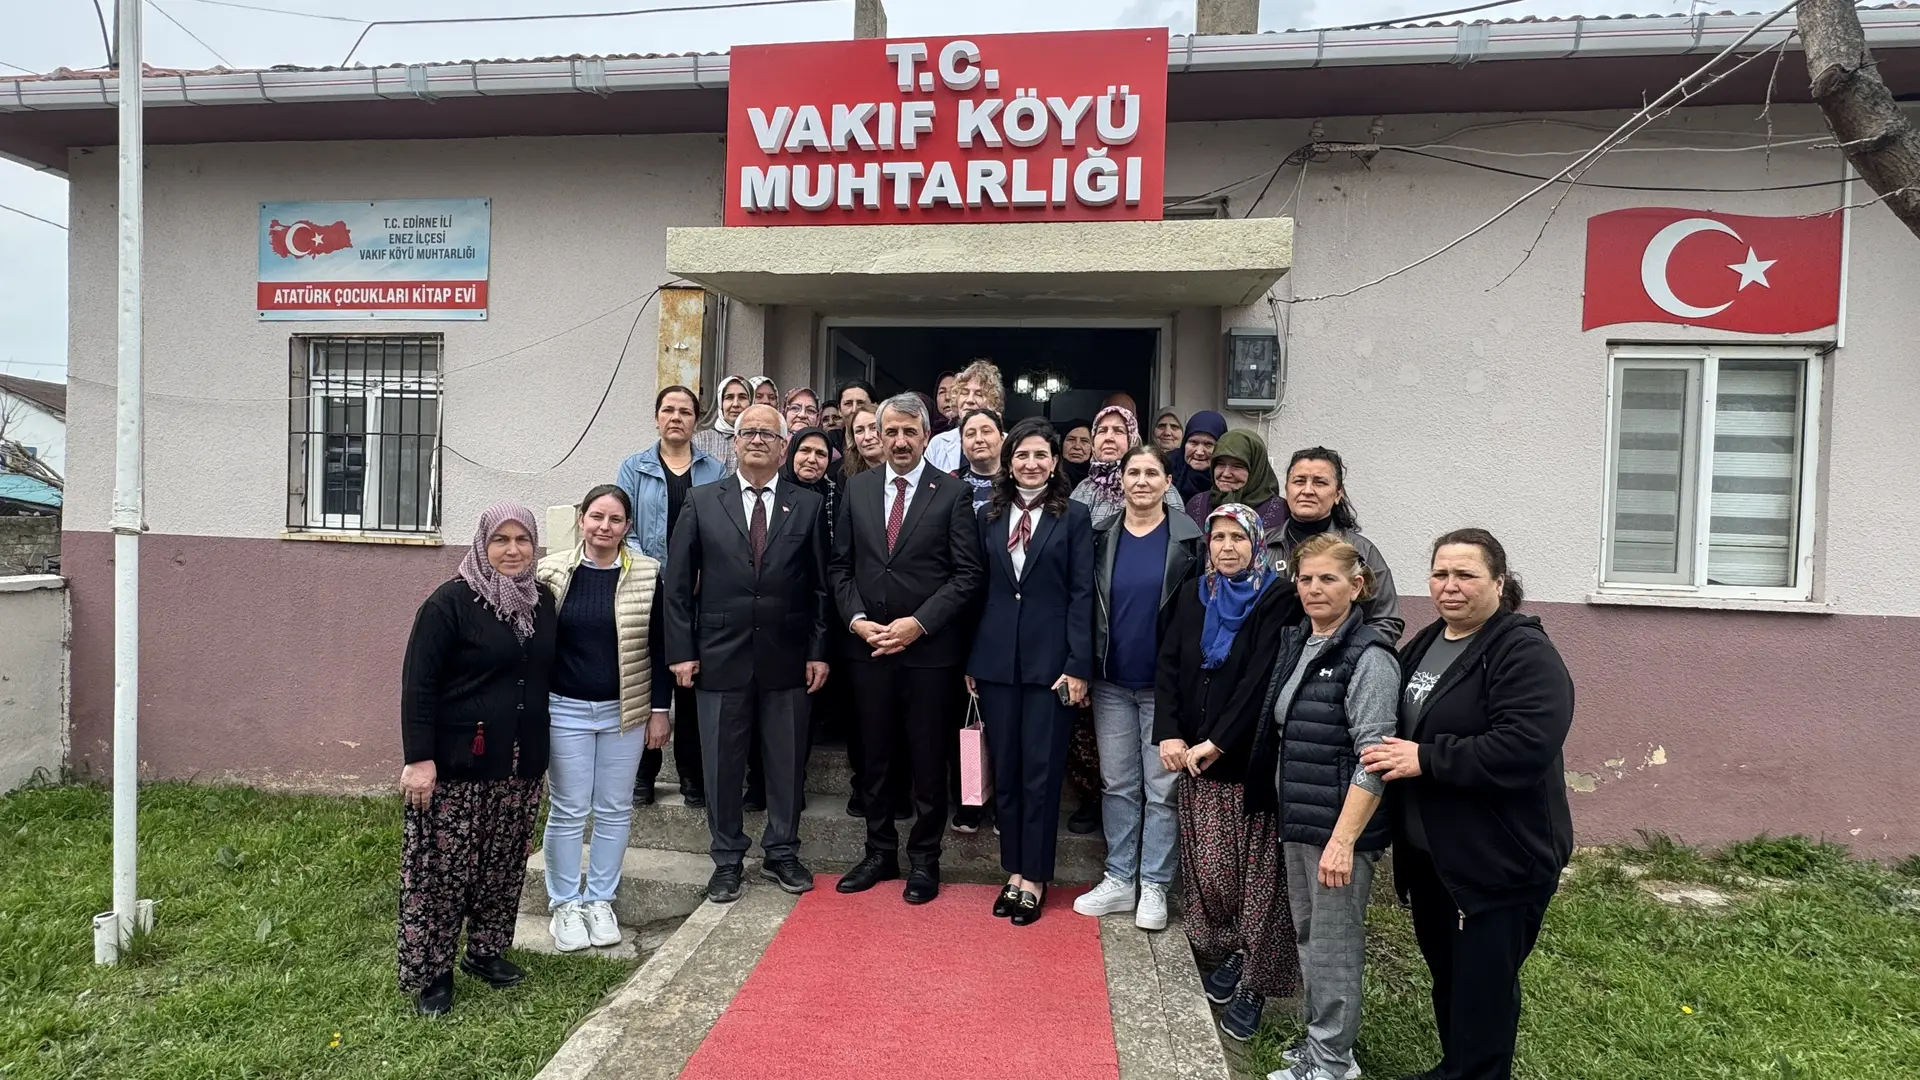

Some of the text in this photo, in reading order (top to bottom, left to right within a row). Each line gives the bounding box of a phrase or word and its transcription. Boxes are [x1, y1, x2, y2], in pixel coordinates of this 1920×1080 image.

[885, 40, 999, 92] T.C.
[747, 85, 1140, 154] VAKIF KÖYÜ
[740, 147, 1142, 213] MUHTARLIĞI
[383, 214, 452, 229] T.C. EDİRNE İLİ
[389, 230, 446, 246] ENEZ İLÇESİ
[359, 246, 475, 260] VAKIF KÖYÜ MUHTARLIĞI
[274, 284, 476, 307] ATATÜRK ÇOCUKLARI KİTAP EVİ
